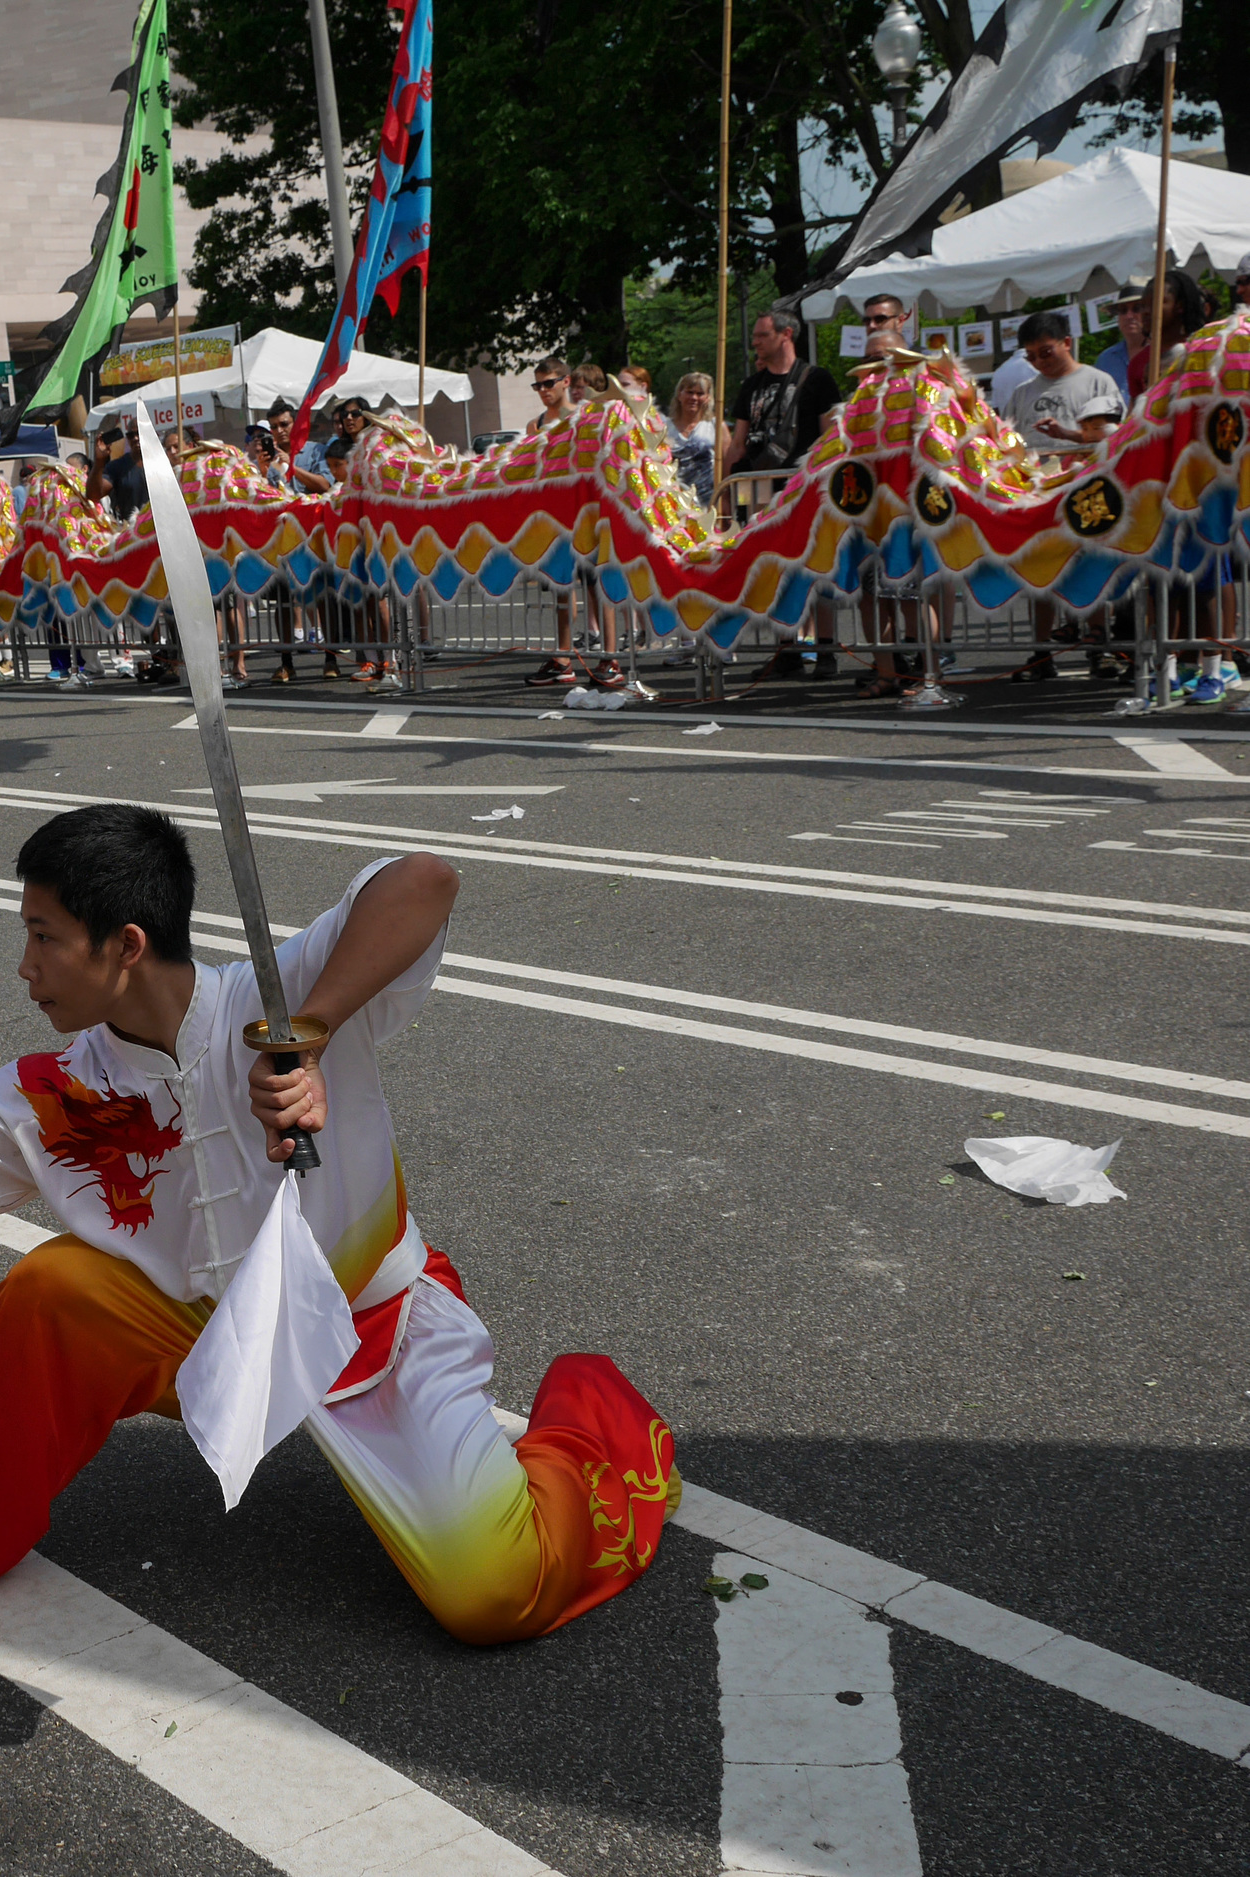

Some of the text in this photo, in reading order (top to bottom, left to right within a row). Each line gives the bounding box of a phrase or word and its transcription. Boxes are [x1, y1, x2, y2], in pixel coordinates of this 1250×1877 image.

[134, 273, 156, 292] OY
[135, 340, 177, 363] SQUEEZE
[180, 337, 231, 355] LEMONADE
[154, 409, 174, 425] Ice
[180, 402, 203, 420] Tea
[787, 790, 1148, 849] TURNS
